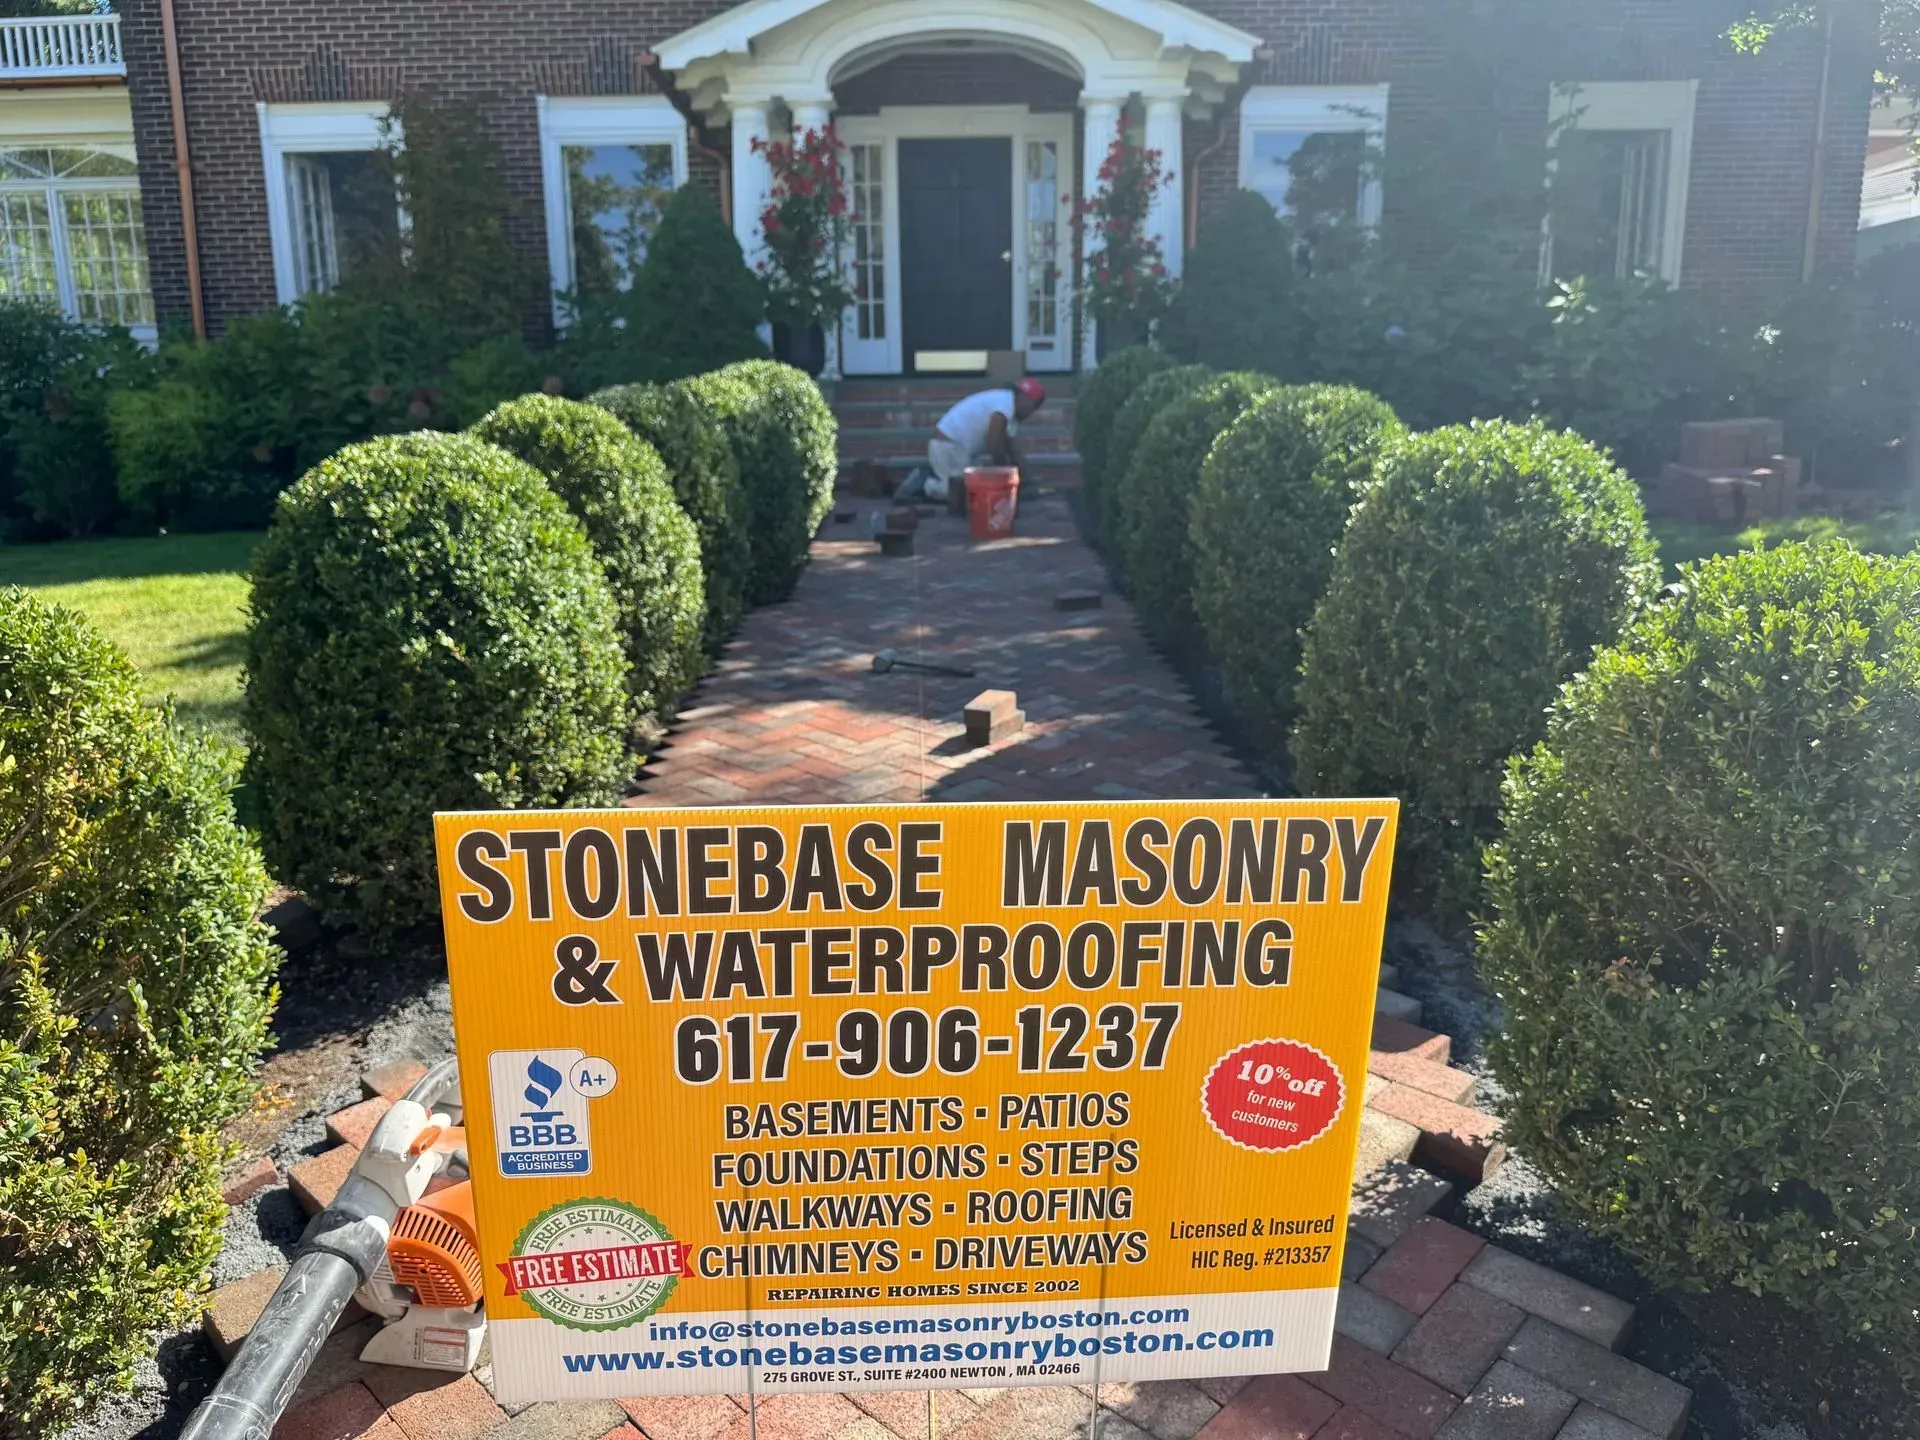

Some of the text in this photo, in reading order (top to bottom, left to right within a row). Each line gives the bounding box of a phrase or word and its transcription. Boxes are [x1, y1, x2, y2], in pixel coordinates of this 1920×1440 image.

[457, 817, 1384, 923] STONEBASE MASONRY
[553, 919, 1293, 1005] & WATERPROOFING
[674, 1003, 1182, 1085] 617-906-1237
[580, 1069, 606, 1087] A+
[724, 1091, 1131, 1140] BASEMENTS PATIOS
[1247, 1090, 1296, 1111] for new
[509, 1124, 577, 1147] BBB
[1231, 1108, 1299, 1133] customers
[507, 1152, 582, 1163] ACCREDITED
[517, 1161, 575, 1171] BUSINESS
[712, 1138, 1139, 1188] FOUNDATIONS STEPS
[714, 1186, 1133, 1233] WALKWAYS ROOFING
[1170, 1215, 1335, 1239] Licensed & Insured
[529, 1208, 653, 1251] FREE ESTIMATE
[512, 1244, 682, 1288] FREE ESTIMATE
[698, 1231, 1148, 1279] CHIMNEYS DRIVEWAYS
[1191, 1246, 1332, 1271] HIC Reg. #213357
[539, 1280, 662, 1320] FREE ESTIMATE
[767, 1280, 1080, 1301] REPAIRING HOMES SINCE 2002
[650, 1308, 1189, 1342] info@stonebasemasonryboston.com
[563, 1328, 1274, 1373] www.stonebasemasonryboston.com
[763, 1371, 788, 1383] 275
[791, 1371, 836, 1383] GROVE
[864, 1369, 902, 1381] SUITE
[904, 1367, 947, 1380] #2400
[1016, 1365, 1036, 1377] MA
[1039, 1363, 1081, 1376] 02466
